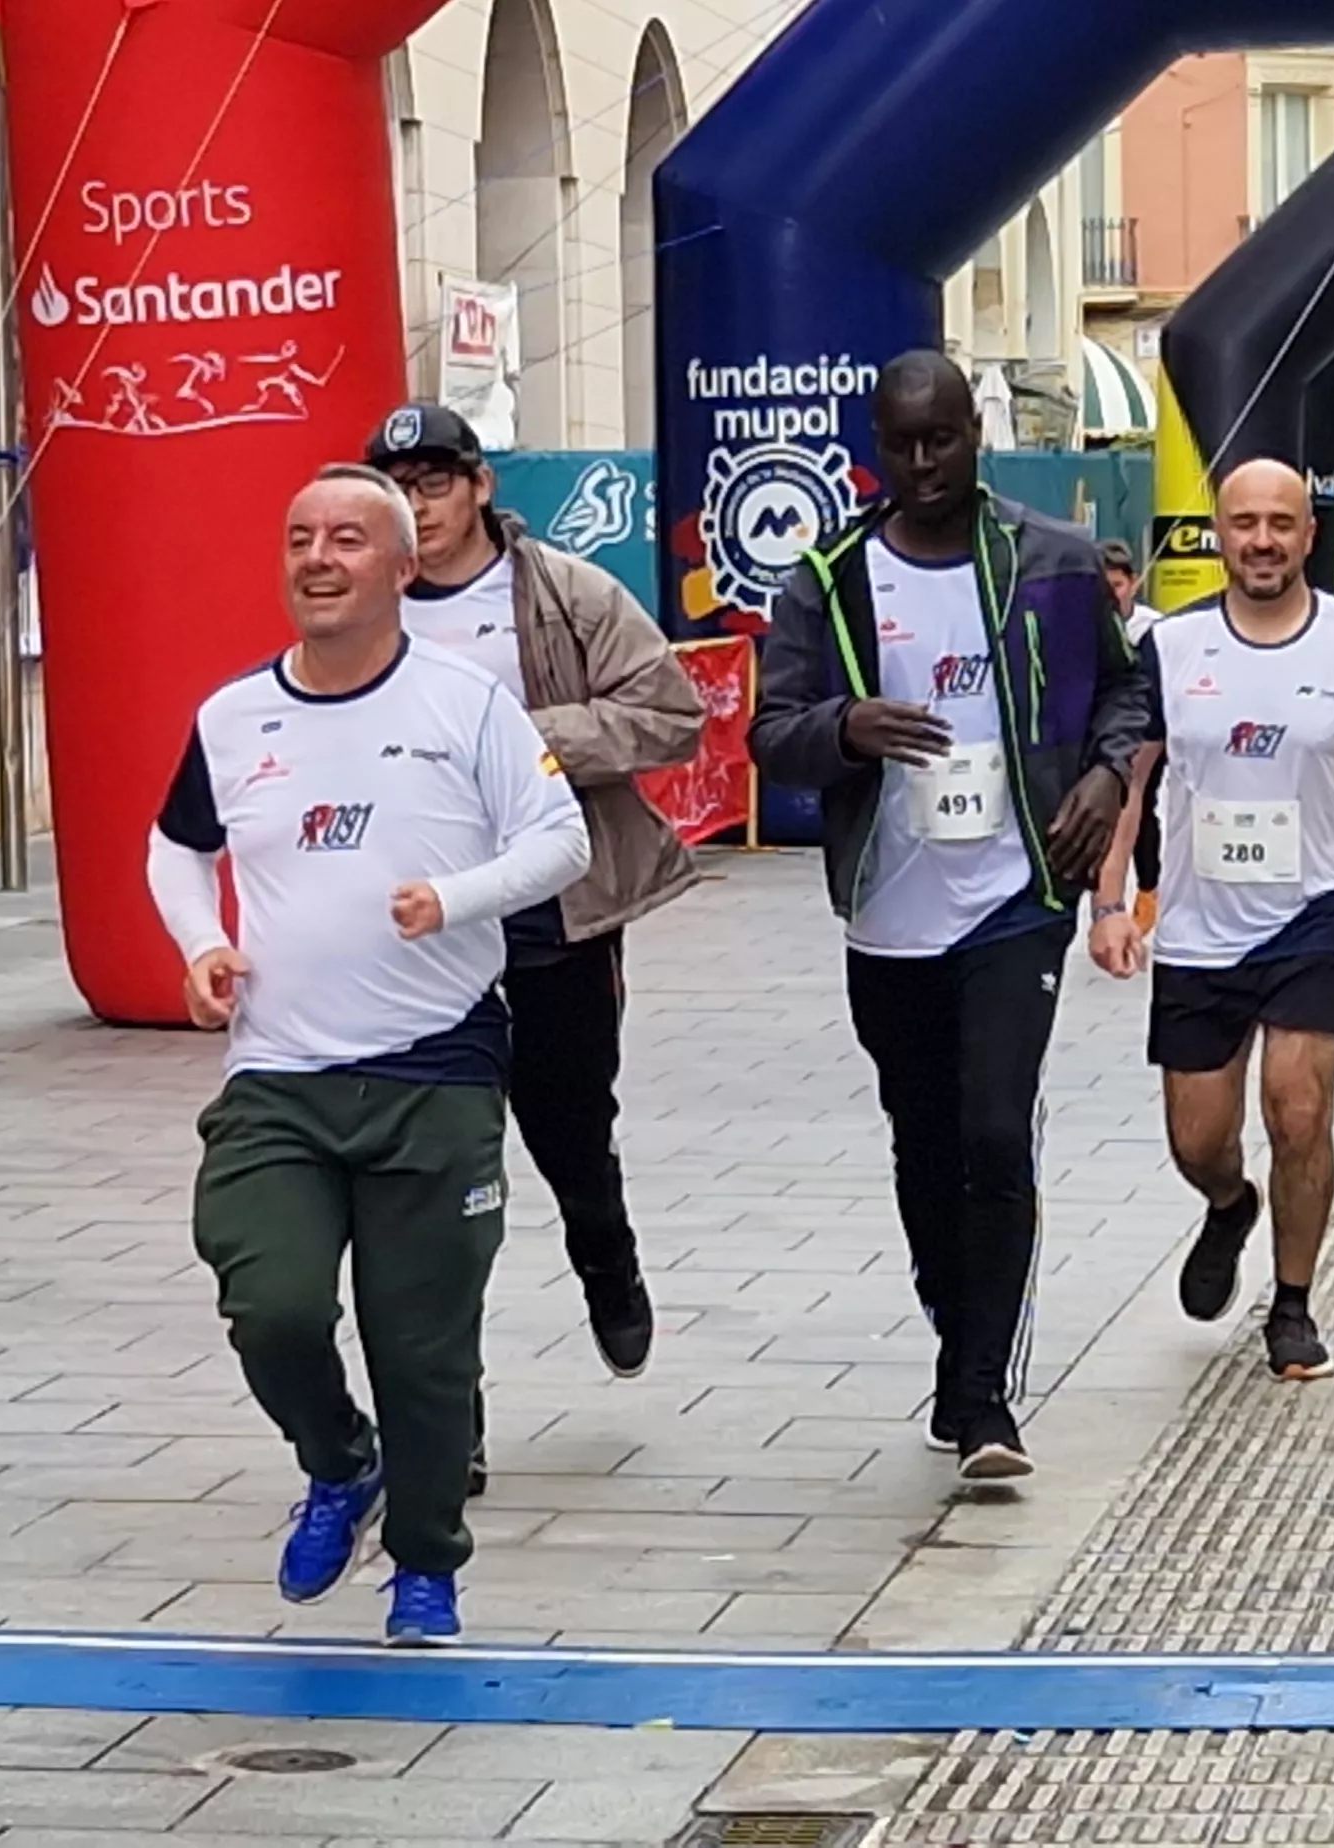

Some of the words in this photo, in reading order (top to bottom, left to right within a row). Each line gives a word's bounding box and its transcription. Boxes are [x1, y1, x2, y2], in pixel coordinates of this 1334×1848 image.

[80, 179, 252, 246] Sports
[75, 264, 342, 326] Santander
[686, 353, 879, 400] fundación
[713, 397, 840, 444] mupol
[936, 792, 983, 816] 491
[1222, 843, 1265, 863] 280
